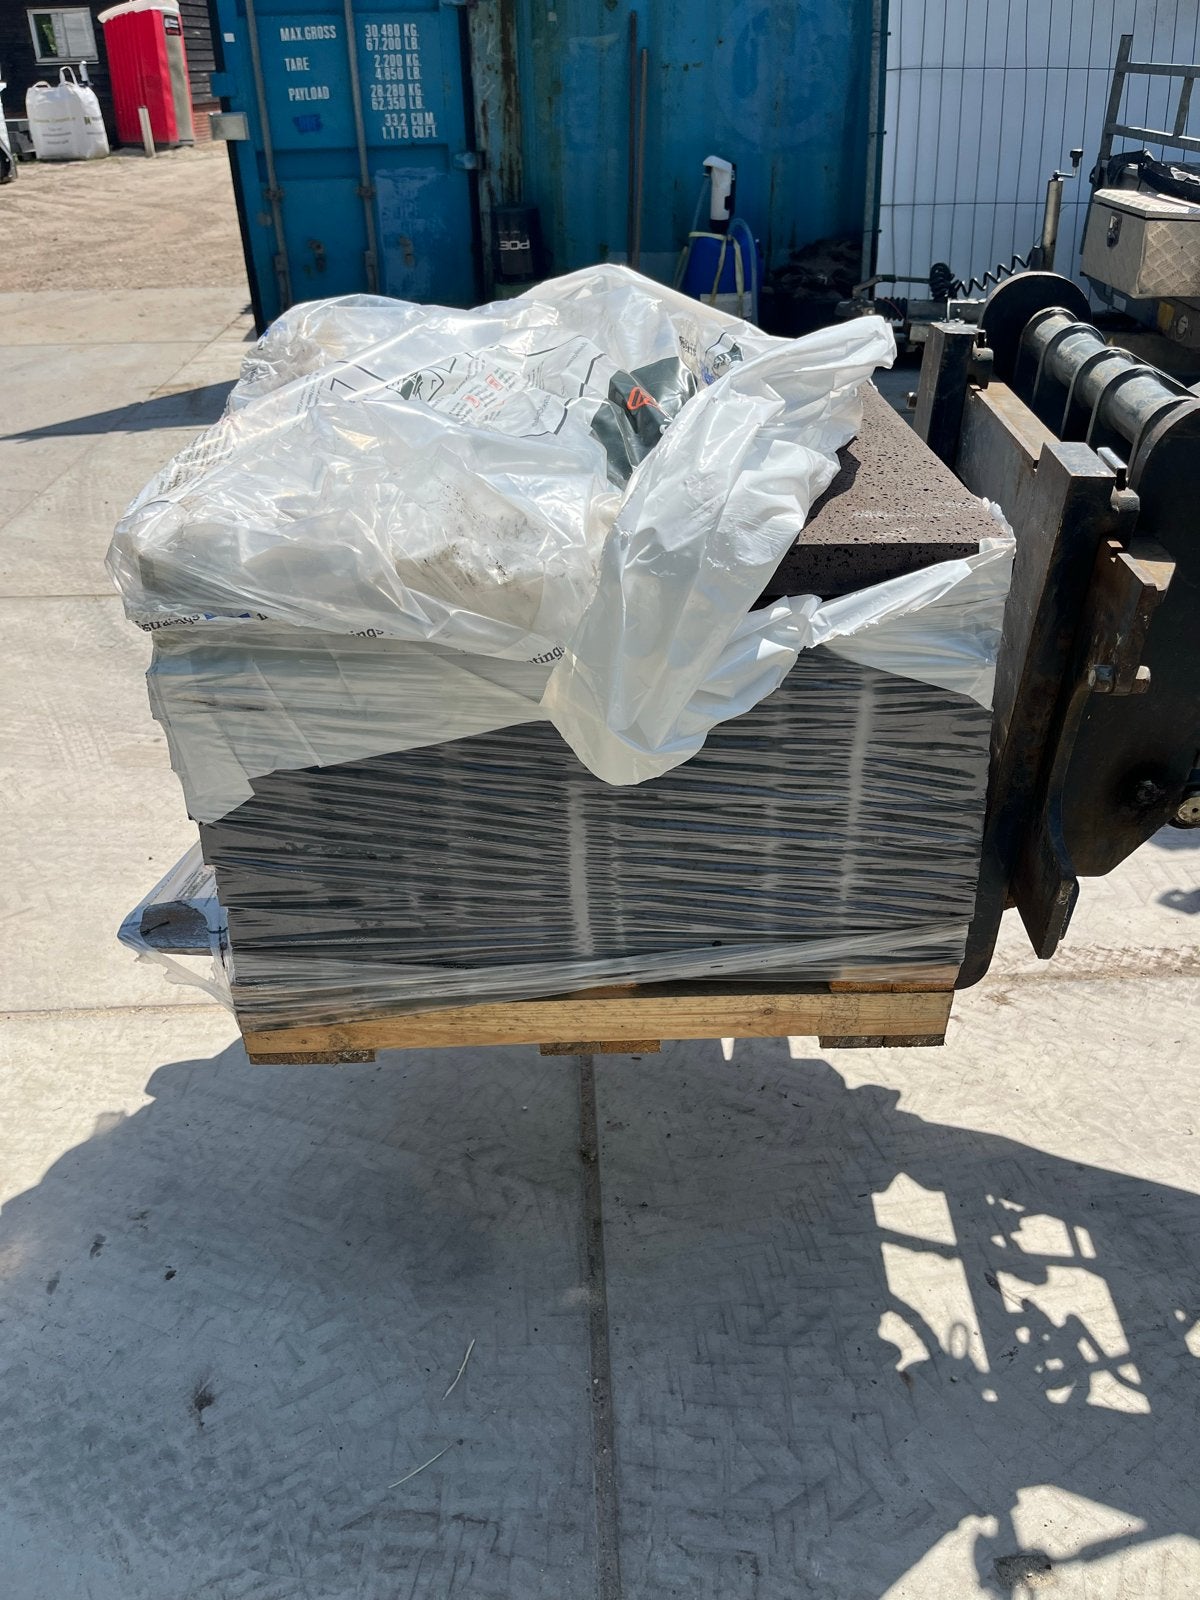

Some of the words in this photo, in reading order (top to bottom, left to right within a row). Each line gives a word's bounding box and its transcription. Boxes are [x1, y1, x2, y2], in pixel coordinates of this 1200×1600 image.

[364, 24, 400, 38] 30.480
[366, 37, 401, 51] 67.200
[284, 57, 310, 71] TARE
[374, 54, 403, 68] 2.200
[288, 86, 330, 101] PAYLOAD
